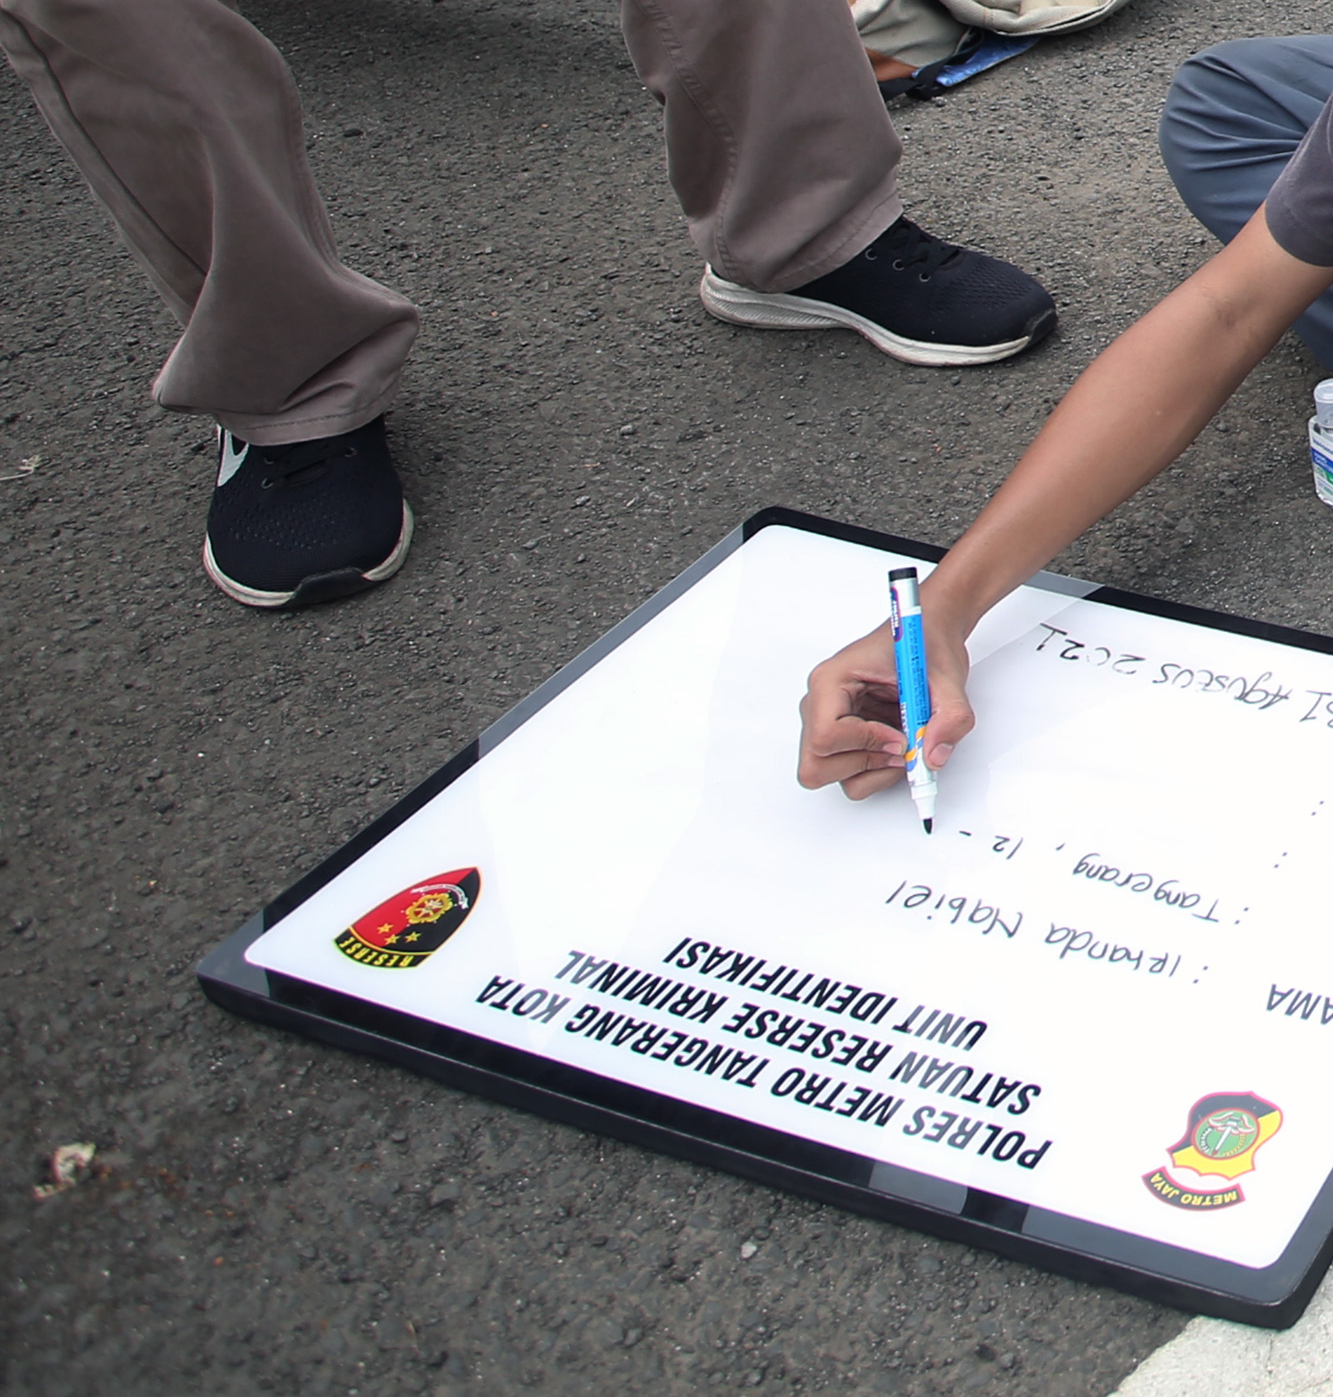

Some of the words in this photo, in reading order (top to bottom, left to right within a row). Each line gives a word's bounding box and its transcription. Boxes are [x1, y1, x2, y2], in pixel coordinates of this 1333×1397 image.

[885, 880, 1024, 939] Nabiel
[338, 936, 415, 967] RESERSE
[662, 936, 898, 1025] IDENTIFIKASI
[474, 974, 571, 1025] KOTA
[553, 949, 728, 1023] KRIMINAL
[564, 1003, 771, 1088] TANGERANG
[723, 1002, 894, 1073] RESERSE
[892, 1004, 988, 1053] UNIT
[771, 1067, 903, 1128] METRO
[889, 1051, 1041, 1116] SATUAN
[902, 1105, 1053, 1170] POLRES
[1150, 1172, 1180, 1198] JAYA
[1180, 1190, 1238, 1207] METRO
